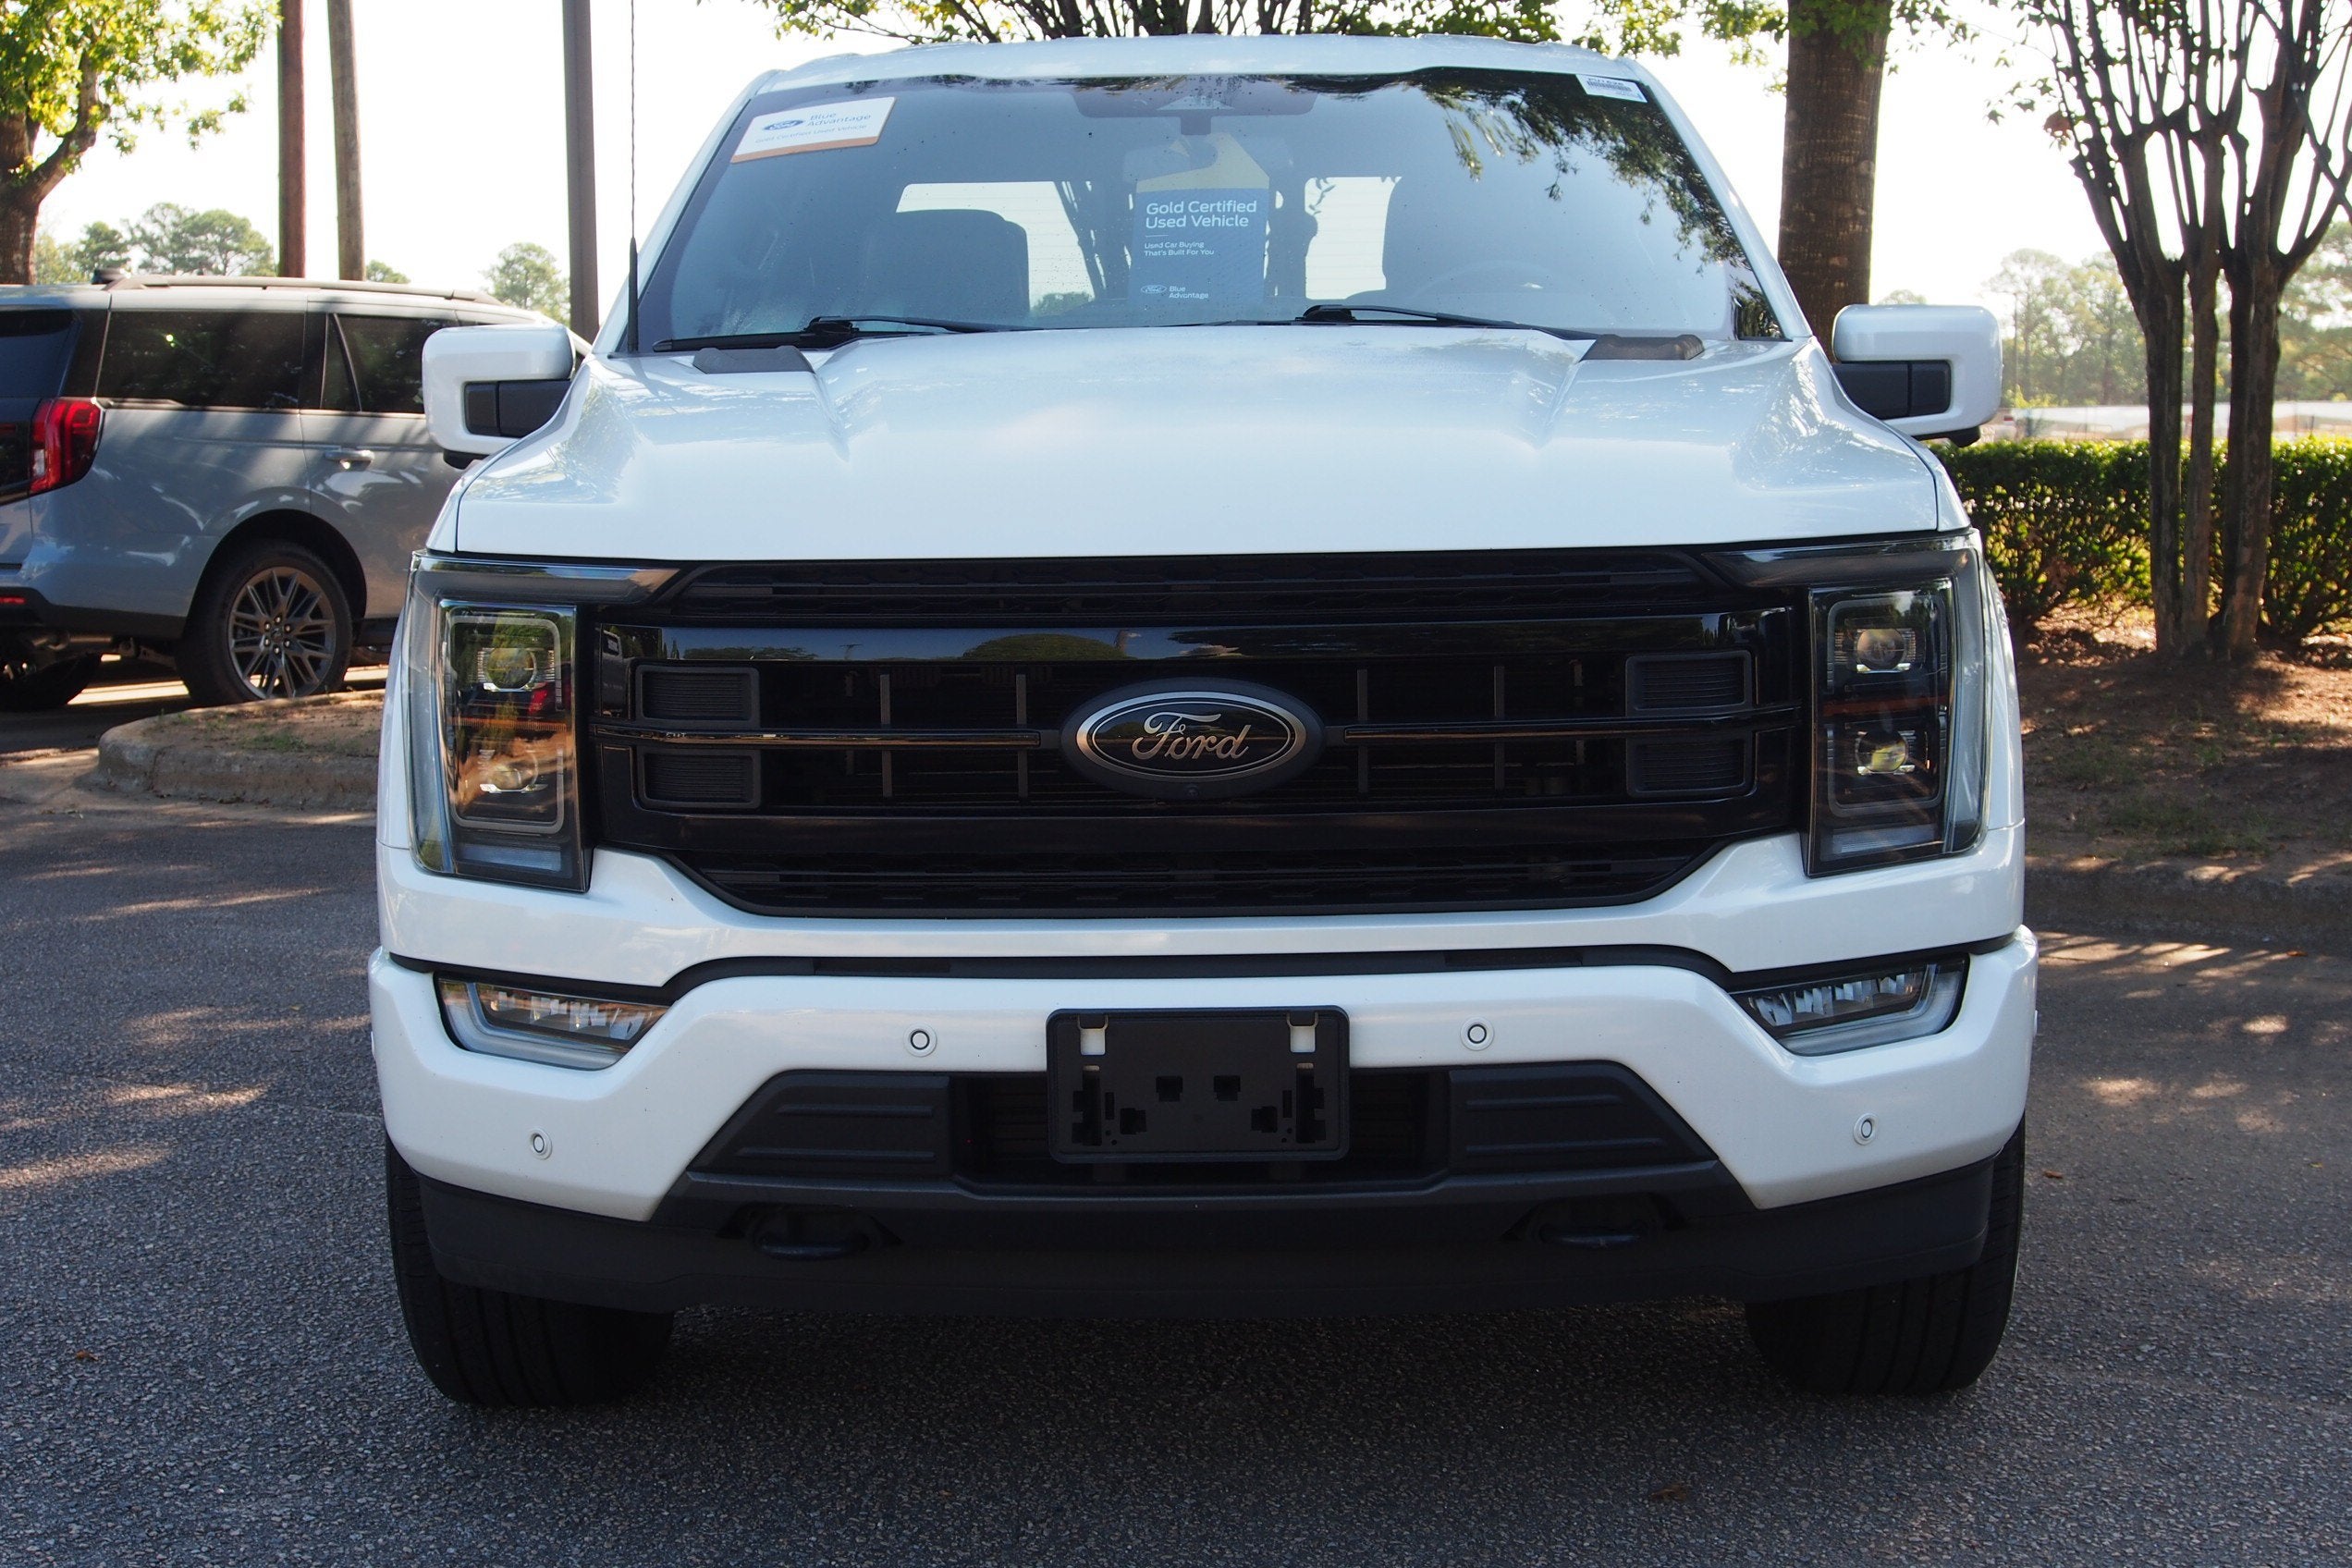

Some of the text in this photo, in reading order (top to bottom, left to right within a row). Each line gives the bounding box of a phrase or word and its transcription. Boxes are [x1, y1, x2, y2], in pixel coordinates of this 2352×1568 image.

[807, 114, 871, 127] Advantage
[810, 112, 837, 121] Blue
[1146, 200, 1257, 214] Gold Certified
[1145, 214, 1249, 229] Used Vehicle
[1144, 241, 1164, 250] Used
[1179, 240, 1205, 249] Buying
[1132, 711, 1252, 760] Ford
